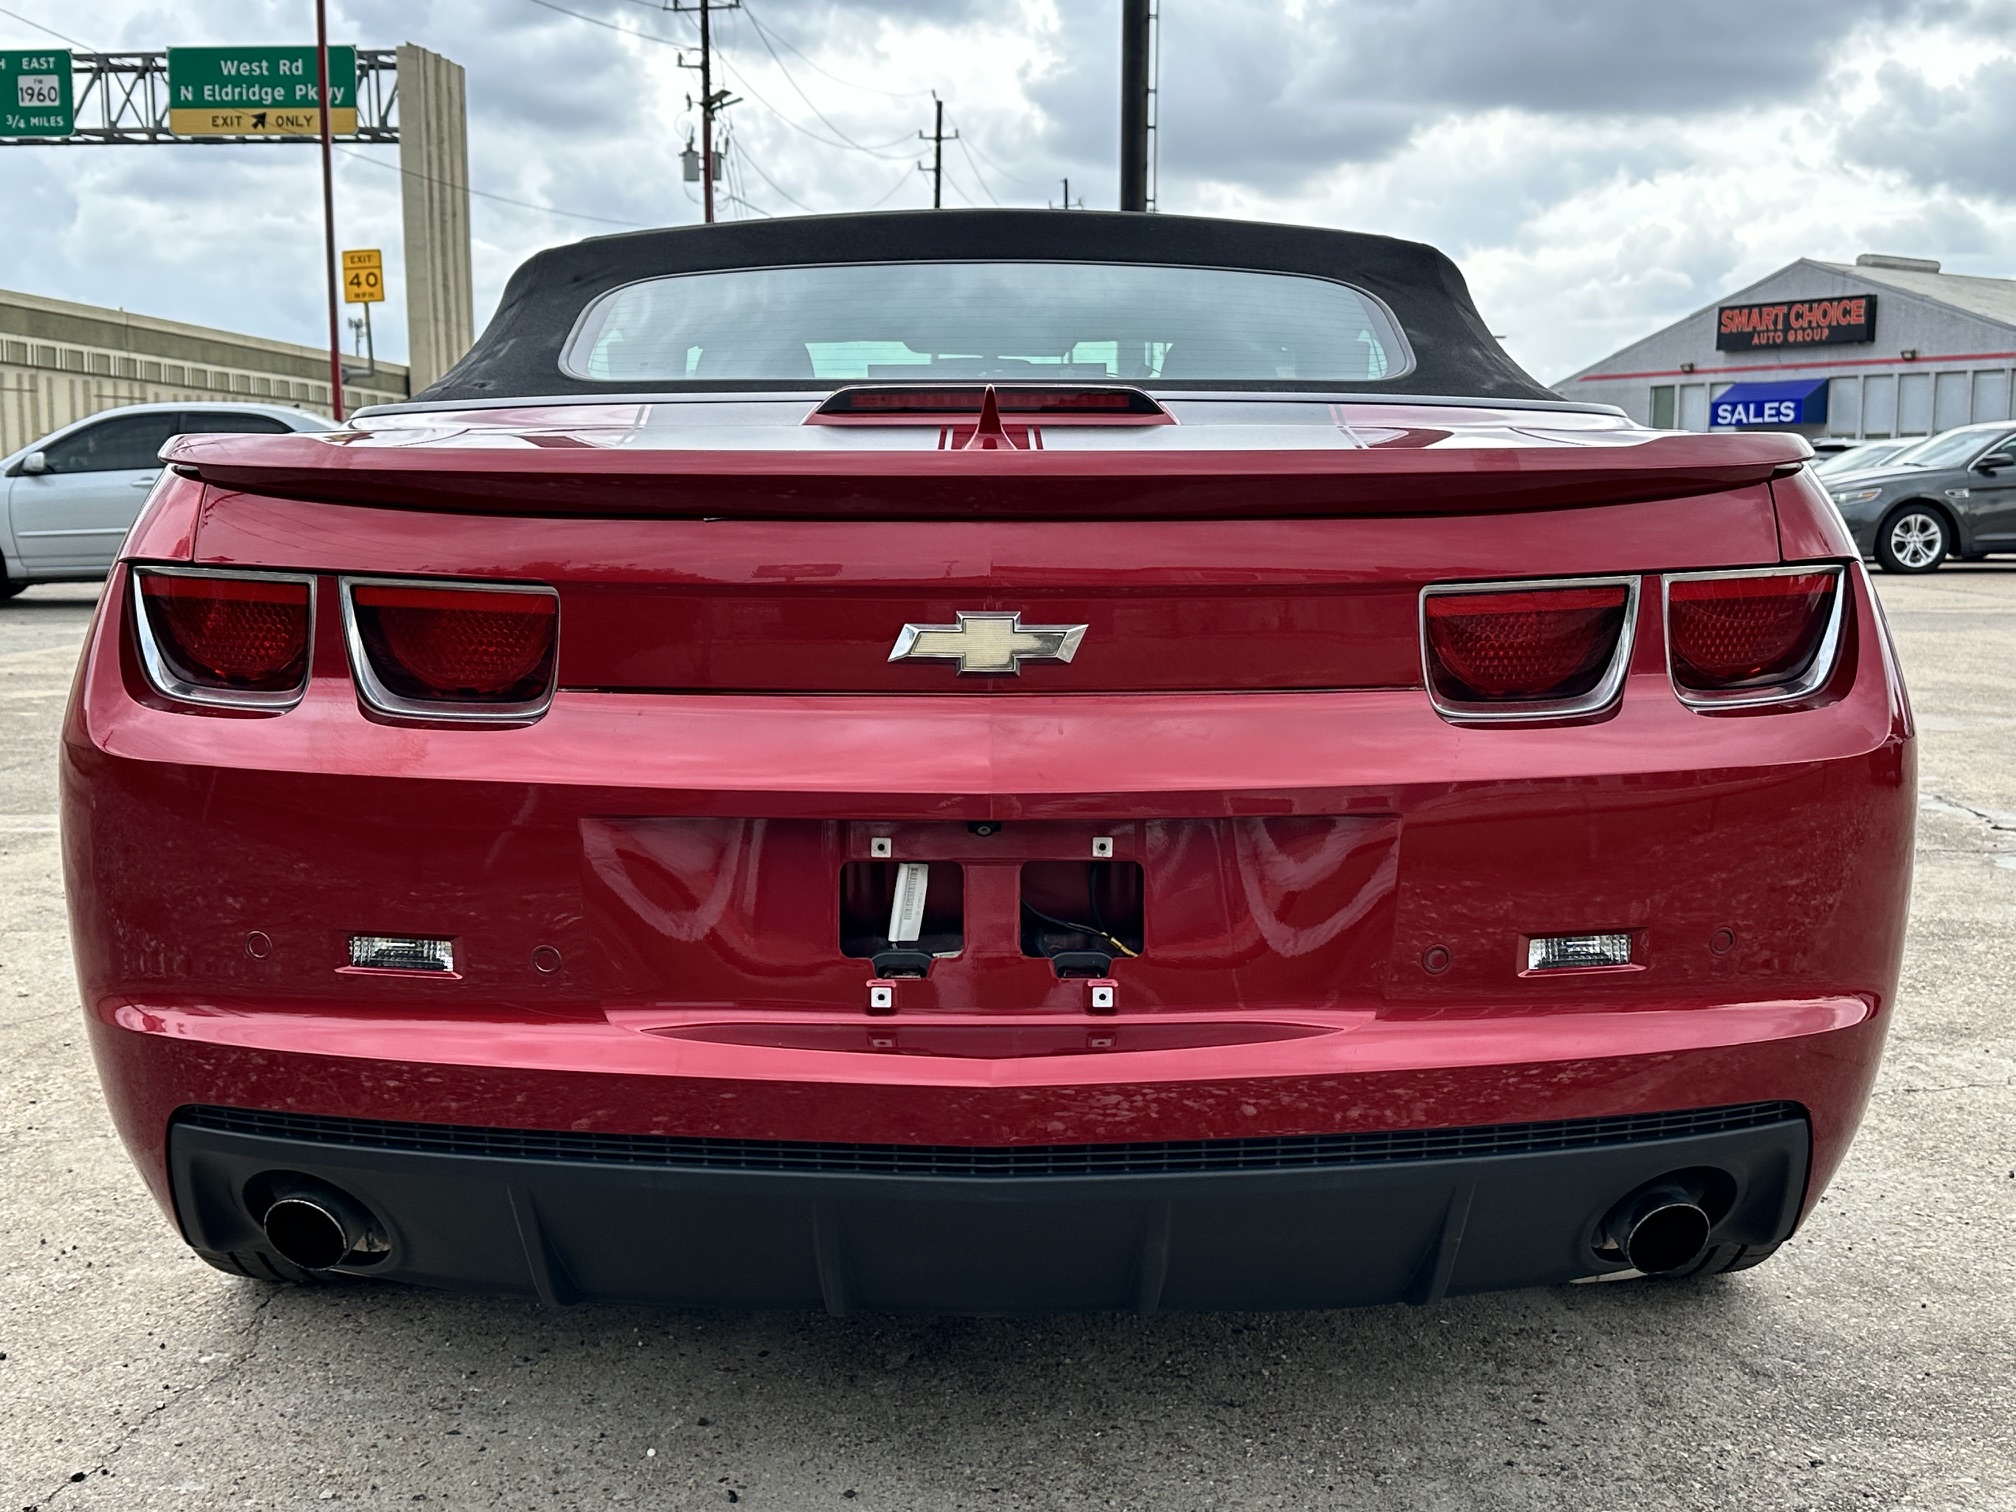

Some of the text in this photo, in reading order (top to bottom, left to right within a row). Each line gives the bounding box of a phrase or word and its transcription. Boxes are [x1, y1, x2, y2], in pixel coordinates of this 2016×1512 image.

[21, 57, 55, 70] EAST
[220, 59, 303, 76] West Rd
[19, 86, 58, 103] 1960
[180, 83, 345, 104] N Eldridge Pky
[30, 116, 64, 127] MILES
[211, 115, 313, 128] EXIT ONLY
[350, 254, 373, 264] EXIT
[348, 271, 378, 288] 40
[1720, 298, 1866, 334] SMART CHOICE
[1751, 328, 1829, 345] AUTO GROUP
[1717, 401, 1796, 424] SALES
